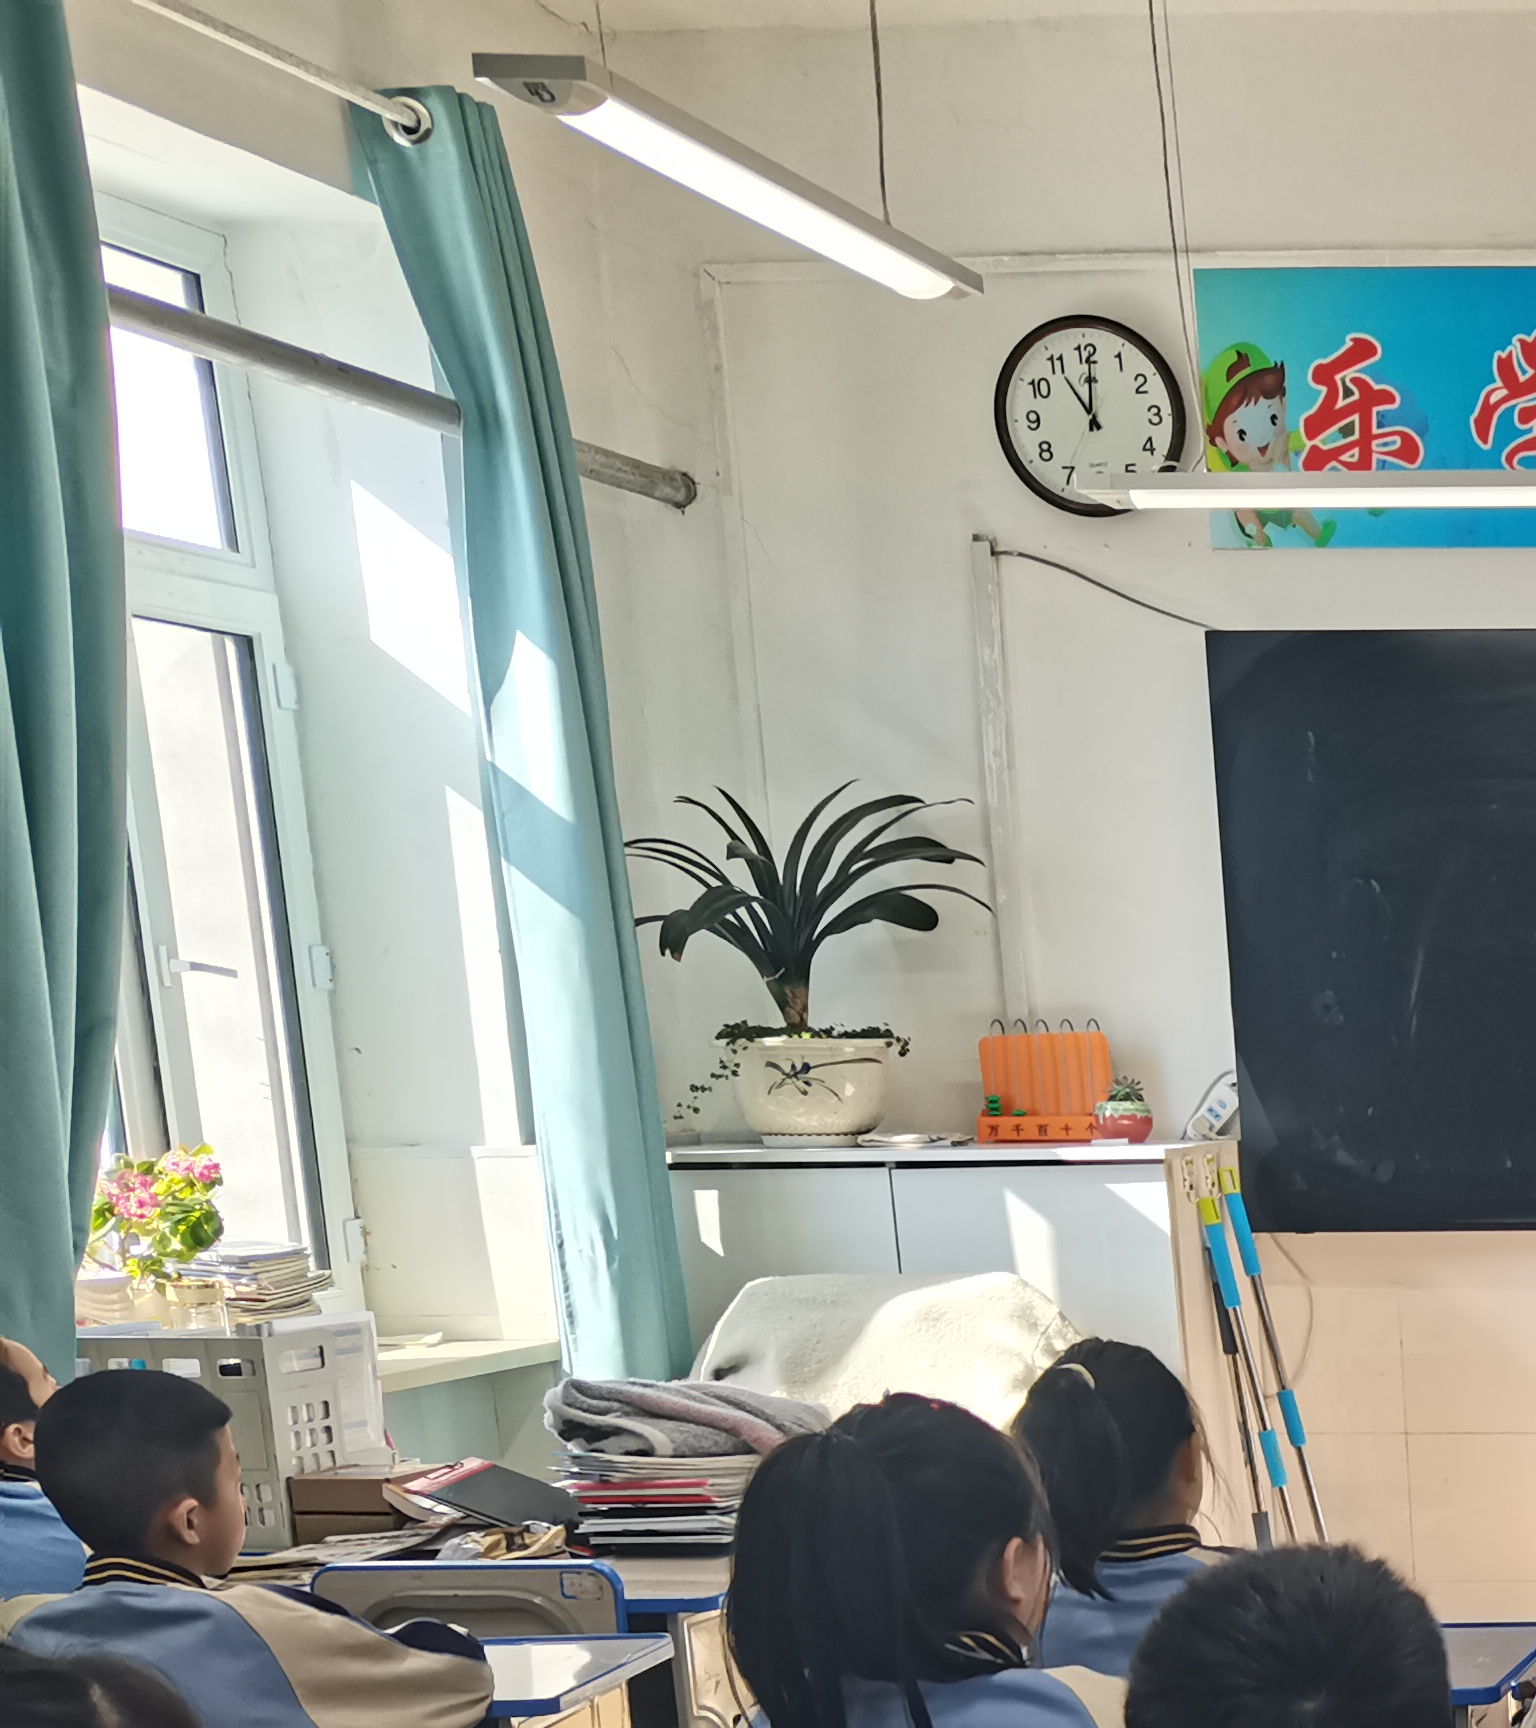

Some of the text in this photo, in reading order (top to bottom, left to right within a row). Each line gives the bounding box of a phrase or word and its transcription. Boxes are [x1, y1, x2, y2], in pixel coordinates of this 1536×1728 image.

[1046, 354, 1065, 375] 11
[1073, 343, 1098, 365] 12
[1113, 351, 1123, 372] 1
[1027, 377, 1051, 399] 10
[1134, 373, 1149, 394] 2
[1025, 410, 1041, 431] 9
[1147, 404, 1163, 426] 3
[1038, 440, 1054, 462] 8
[1142, 436, 1156, 456] 4
[1061, 465, 1075, 486] 7
